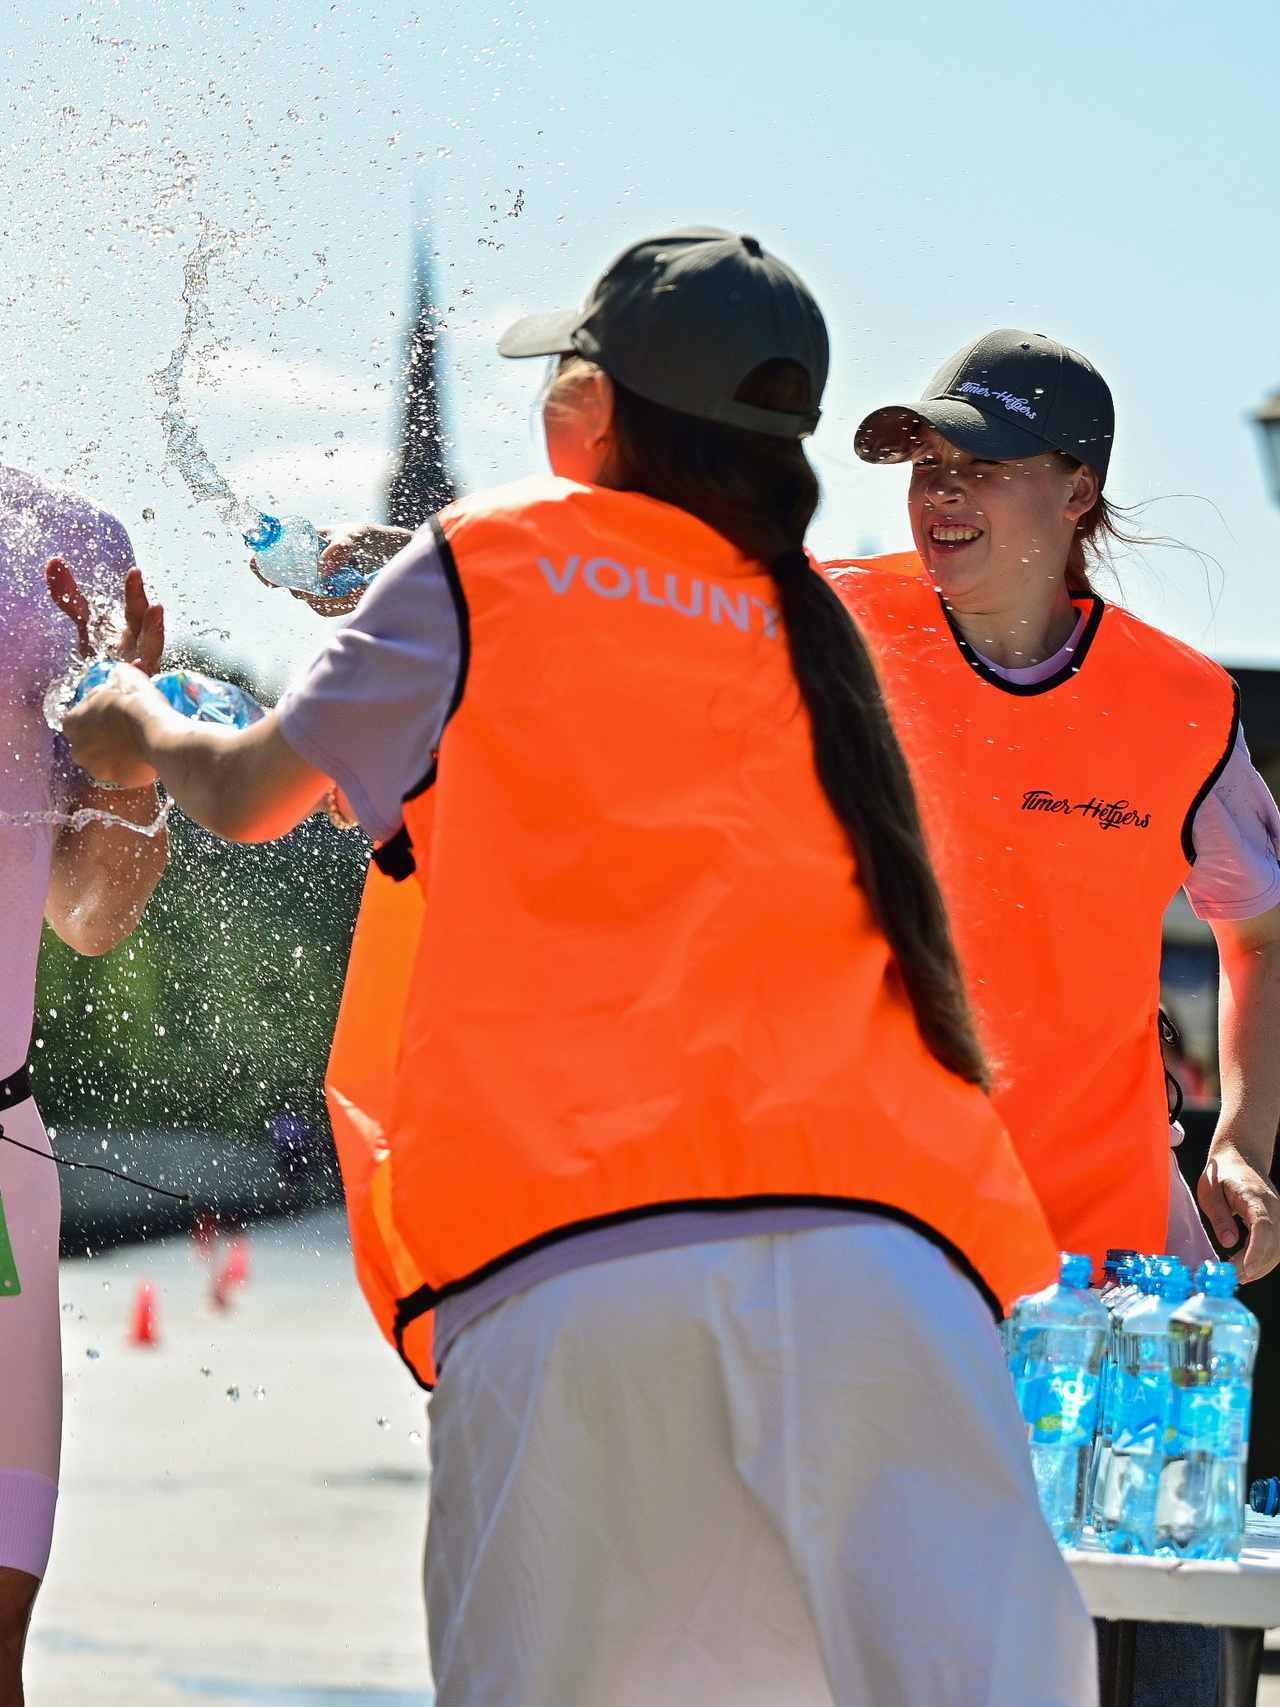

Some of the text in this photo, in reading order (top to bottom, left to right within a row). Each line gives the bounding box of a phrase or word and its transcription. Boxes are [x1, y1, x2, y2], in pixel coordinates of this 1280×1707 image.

[956, 382, 1037, 420] Timer Helpers
[1021, 790, 1152, 830] Timer Helpers
